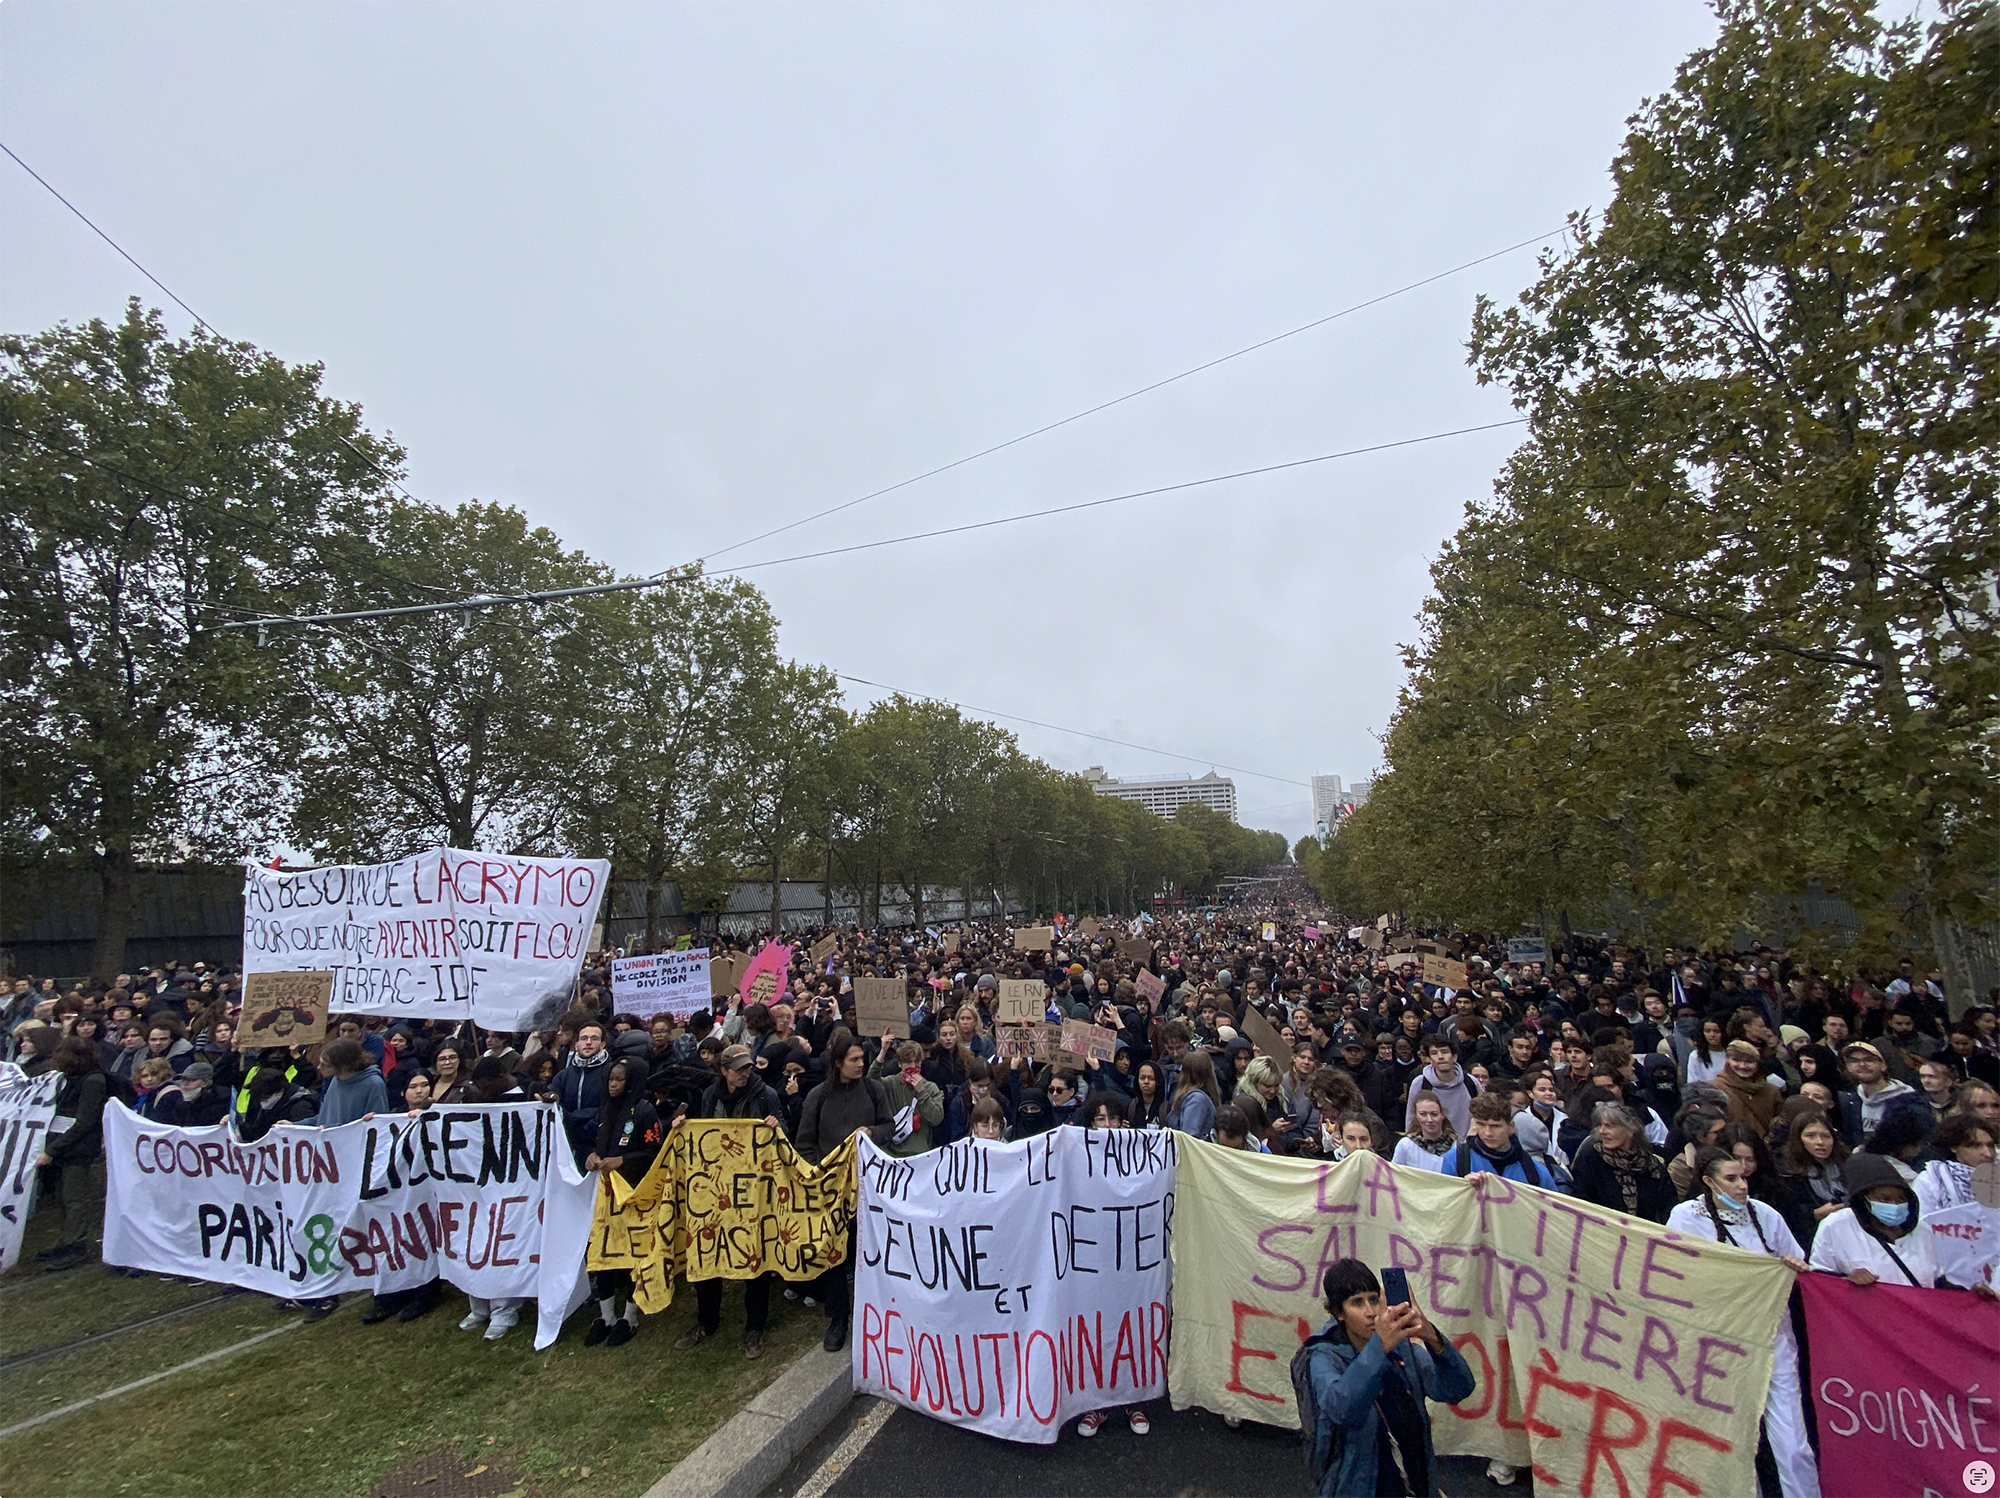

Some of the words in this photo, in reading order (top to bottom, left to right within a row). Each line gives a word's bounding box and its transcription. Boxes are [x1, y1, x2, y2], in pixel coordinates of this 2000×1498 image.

[413, 857, 595, 908] LACRYMO
[246, 916, 289, 954] POUR
[291, 925, 330, 951] QUE
[332, 922, 376, 955] NOTRE
[375, 918, 459, 959] AVENIR
[458, 918, 514, 953] SOIT
[513, 922, 583, 960] FLOU
[615, 974, 626, 983] NE
[661, 966, 678, 976] PAS
[689, 963, 702, 972] LA
[656, 955, 676, 966] FAIT
[636, 974, 687, 988] DIVISION
[1008, 985, 1021, 998] LE
[1024, 983, 1042, 997] RN
[1008, 999, 1042, 1017] TUE
[1008, 1041, 1036, 1056] CNRS
[1026, 1131, 1058, 1186] LE
[790, 1173, 838, 1212] LES
[1315, 1156, 1403, 1222] LA
[303, 1213, 345, 1276] &
[1050, 1192, 1175, 1281] DETER
[995, 1284, 1032, 1314] ET
